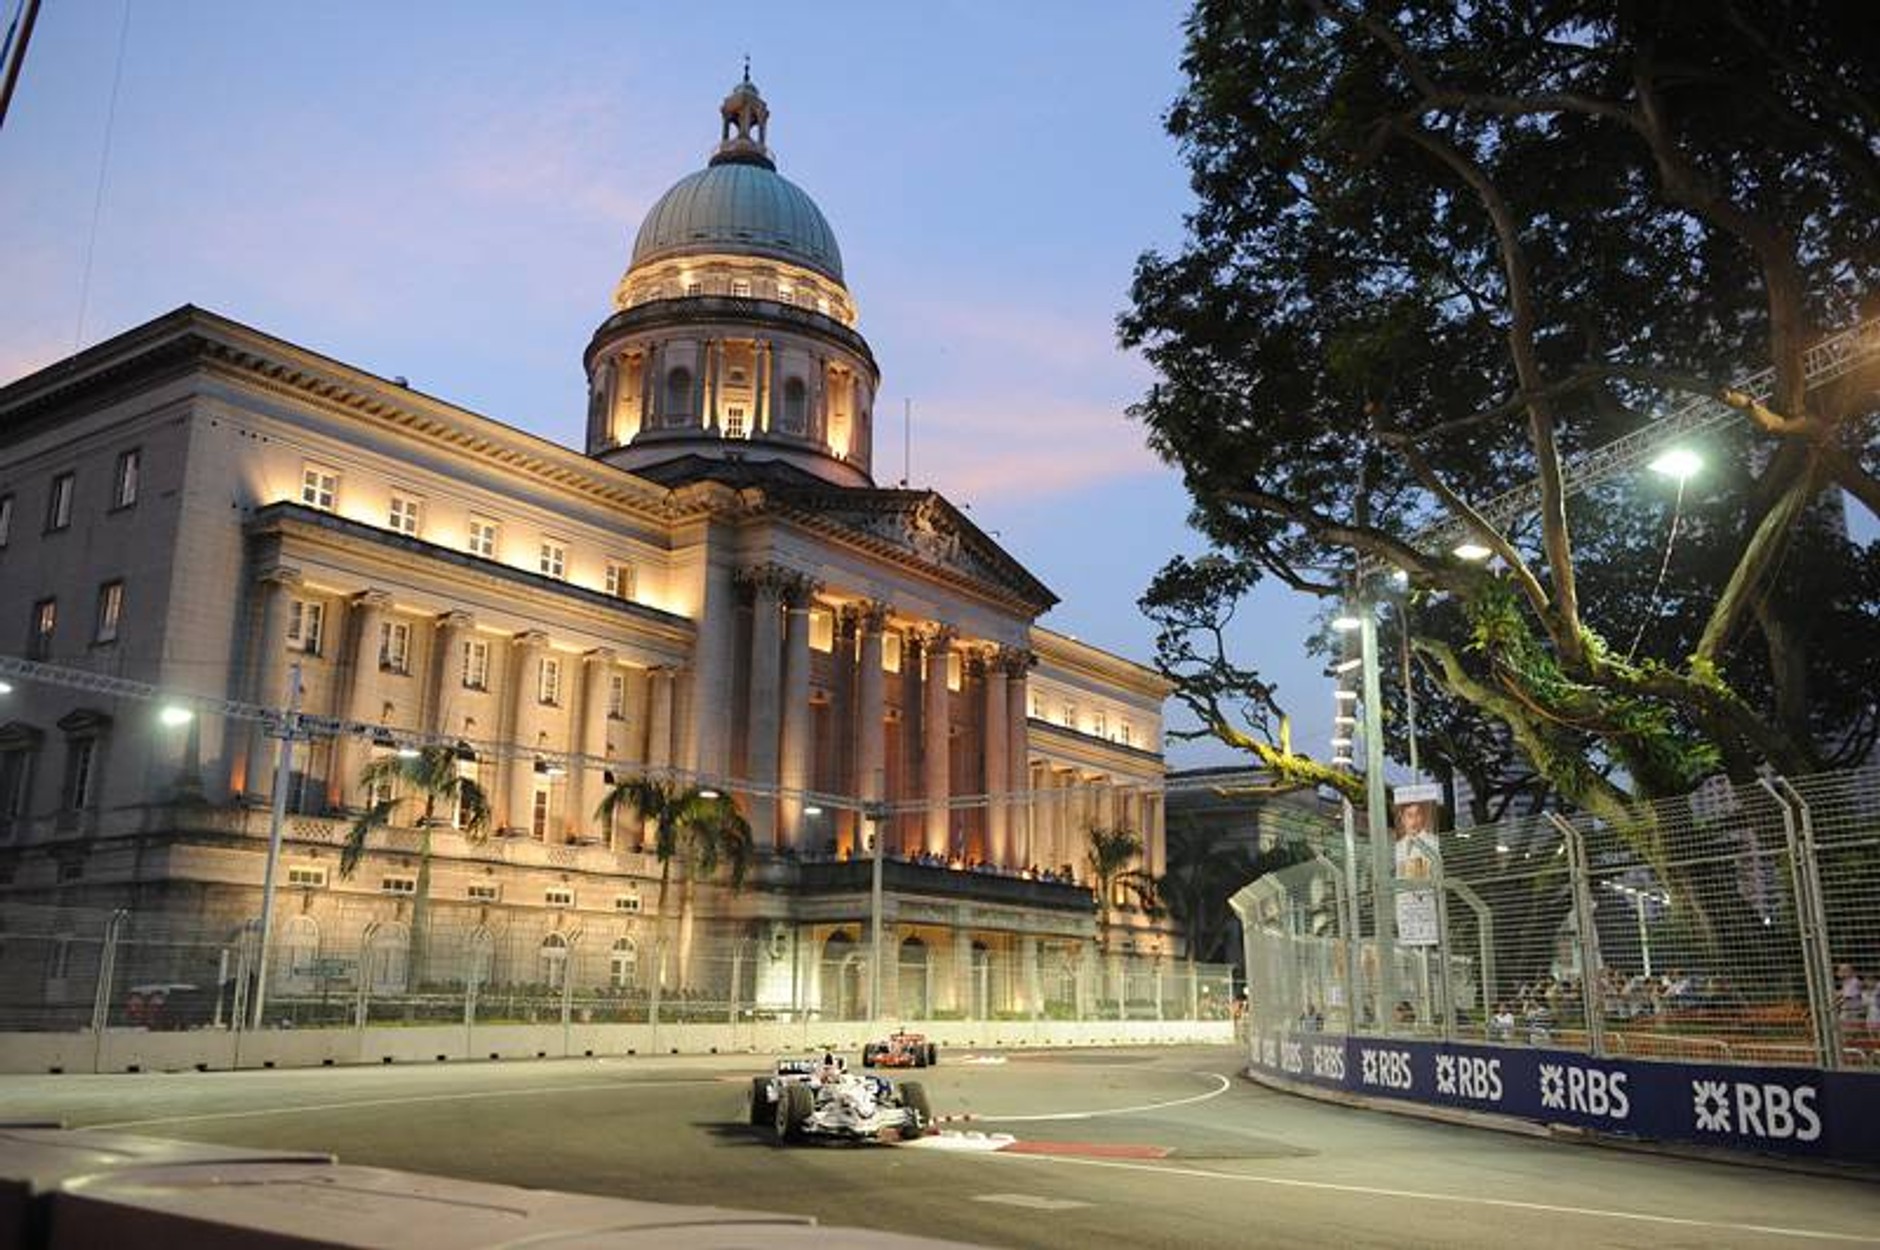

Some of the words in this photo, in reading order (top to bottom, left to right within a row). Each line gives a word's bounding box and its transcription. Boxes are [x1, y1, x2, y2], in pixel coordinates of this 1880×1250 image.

[1321, 1046, 1345, 1081] RBS
[1379, 1052, 1412, 1089] RBS
[1458, 1056, 1502, 1100] RBS
[1567, 1066, 1630, 1119] RBS
[1735, 1083, 1821, 1141] RBS
